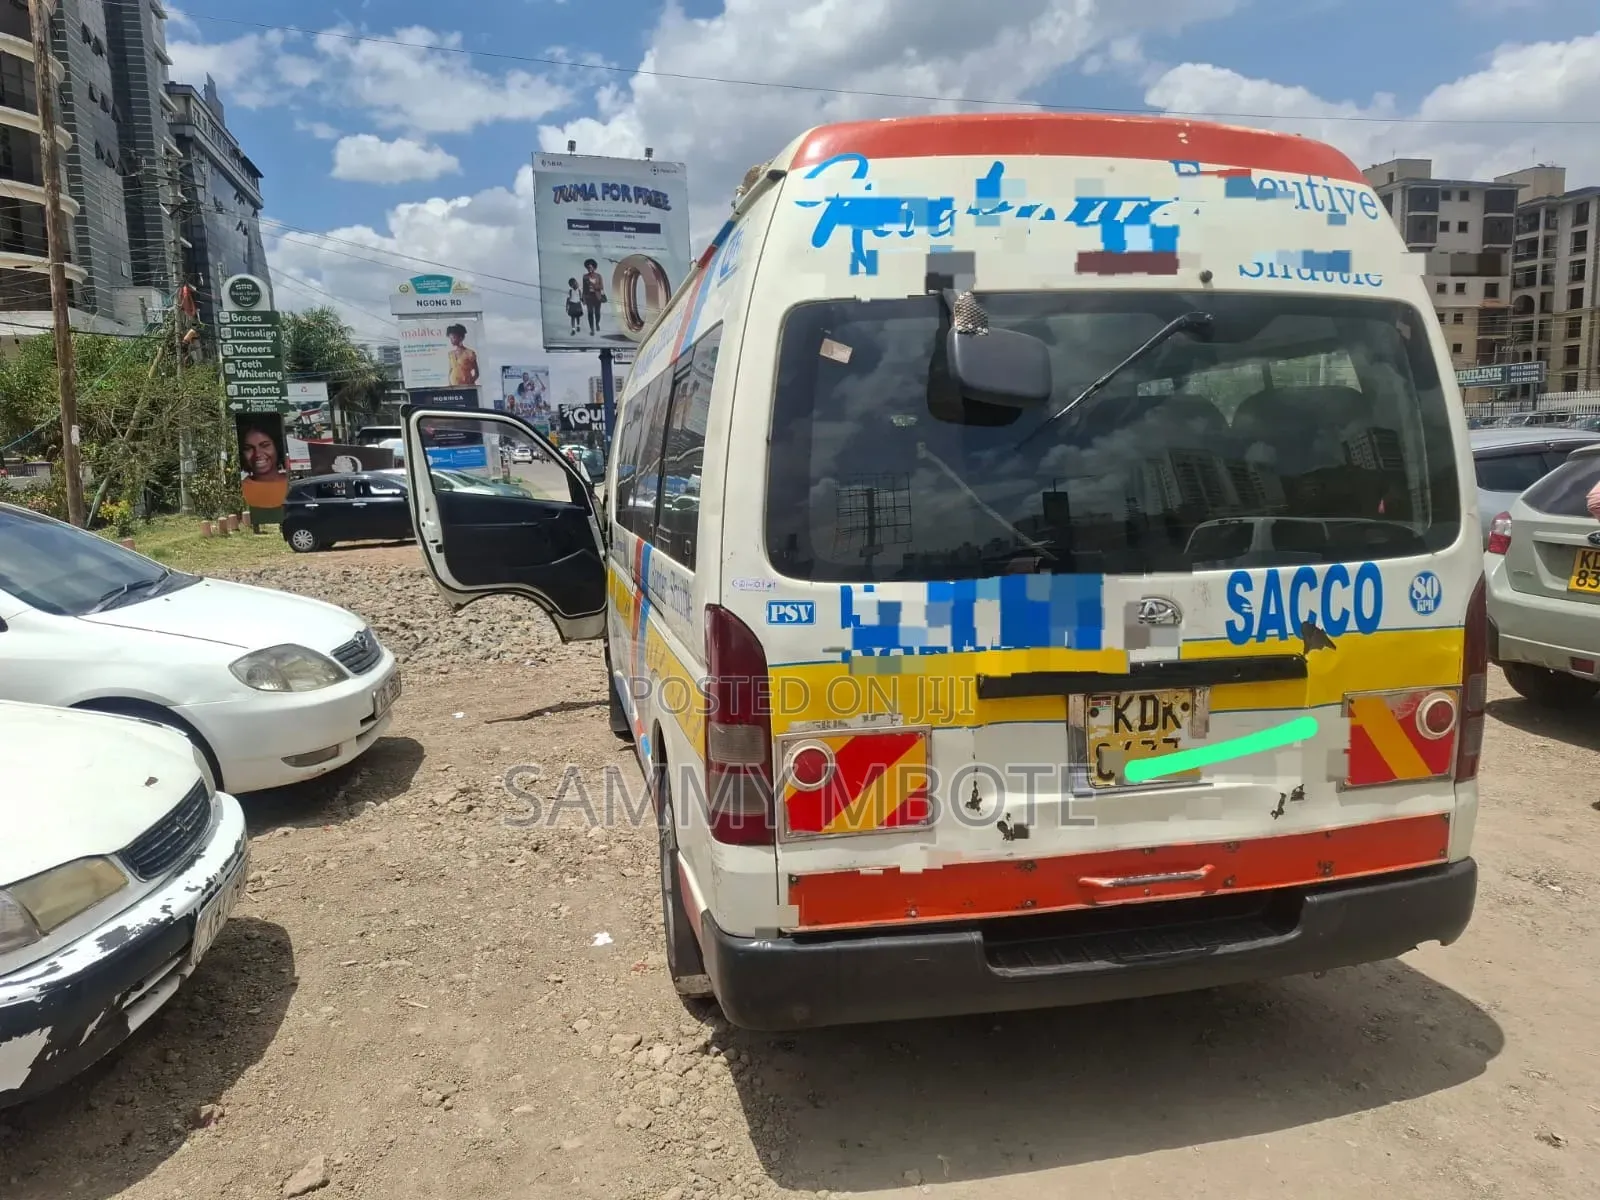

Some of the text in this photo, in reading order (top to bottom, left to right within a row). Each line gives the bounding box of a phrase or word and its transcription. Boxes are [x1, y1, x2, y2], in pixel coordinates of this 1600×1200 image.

[553, 182, 673, 212] TUMA FOR FREE
[416, 299, 448, 307] NGONG
[231, 313, 262, 322] Braces
[233, 328, 277, 341] Invisalign
[234, 345, 272, 354] Veneers
[235, 360, 263, 369] Teeth
[236, 369, 283, 380] Whitening
[240, 385, 281, 396] Implants
[1412, 575, 1439, 600] 80
[1225, 562, 1383, 645] SACCO
[1417, 599, 1435, 612] KPH
[770, 604, 813, 622] PSV
[1113, 695, 1182, 733] KDK
